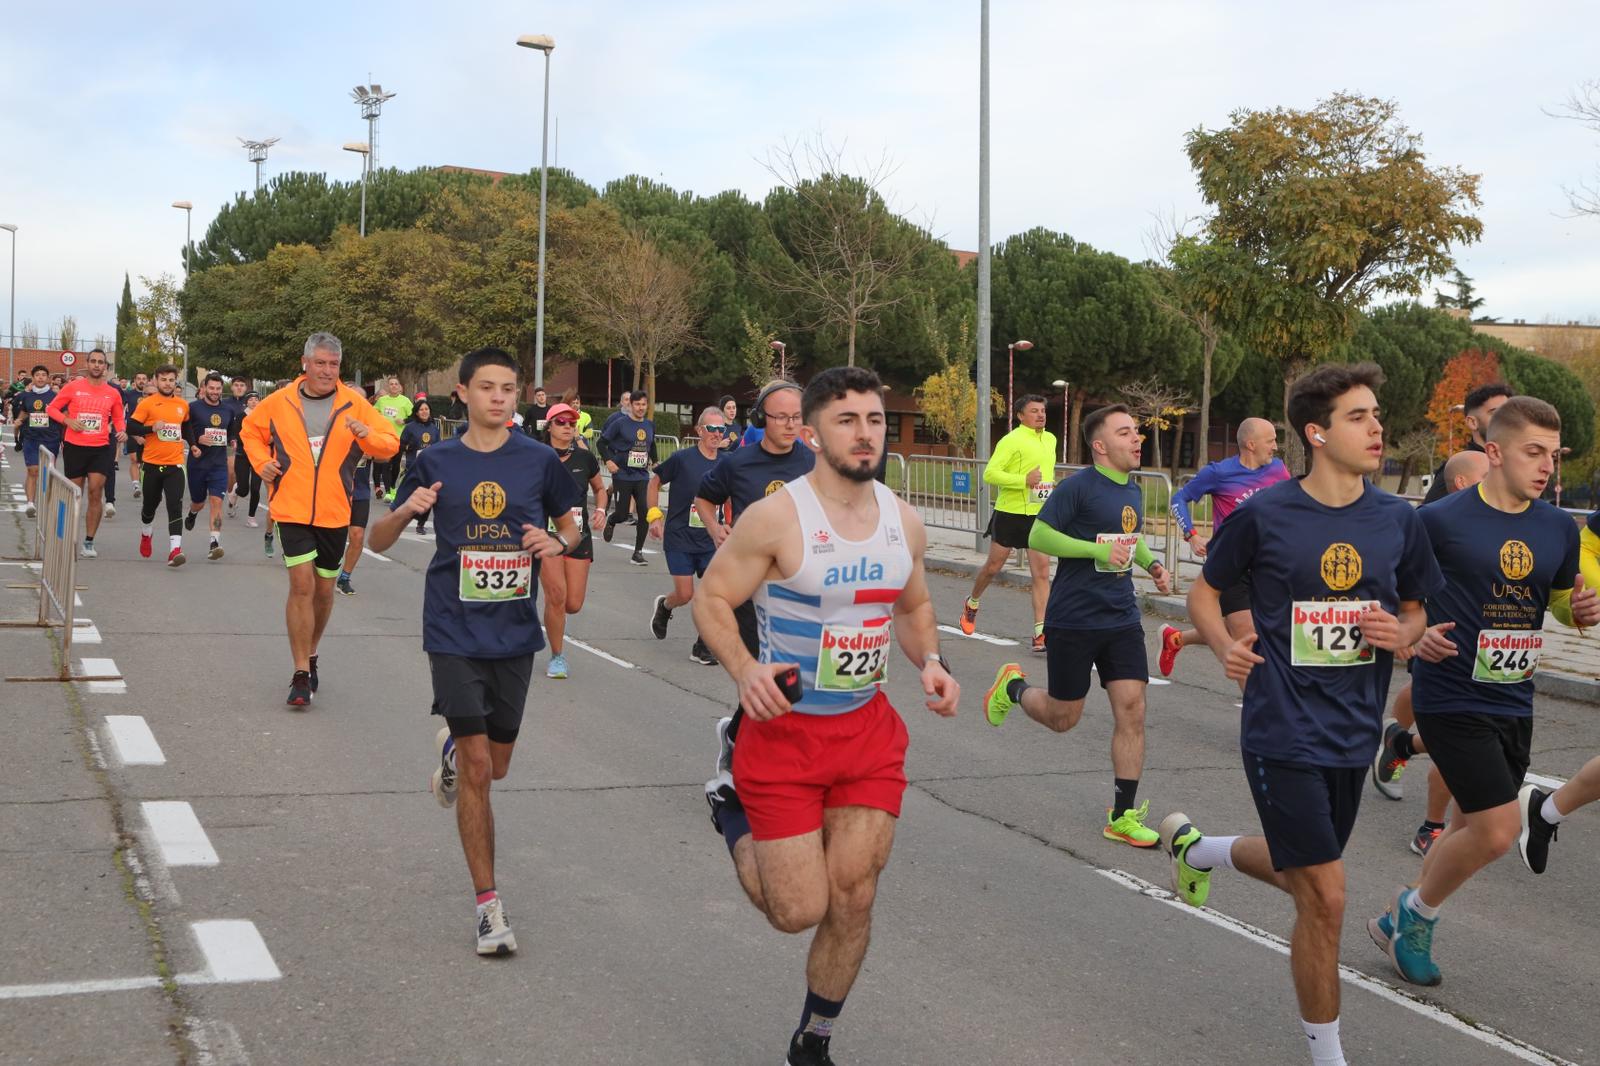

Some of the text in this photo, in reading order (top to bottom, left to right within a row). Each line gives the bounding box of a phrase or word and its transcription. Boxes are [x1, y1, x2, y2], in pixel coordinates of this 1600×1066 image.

[162, 429, 178, 438] 206
[466, 524, 511, 539] UPSA
[463, 555, 530, 570] bedunia
[475, 571, 518, 589] 332
[823, 556, 884, 587] aula
[1492, 583, 1533, 600] UPSA
[1311, 625, 1362, 650] 129
[1479, 634, 1543, 650] bedunia
[835, 648, 881, 676] 223
[1489, 650, 1529, 671] 246
